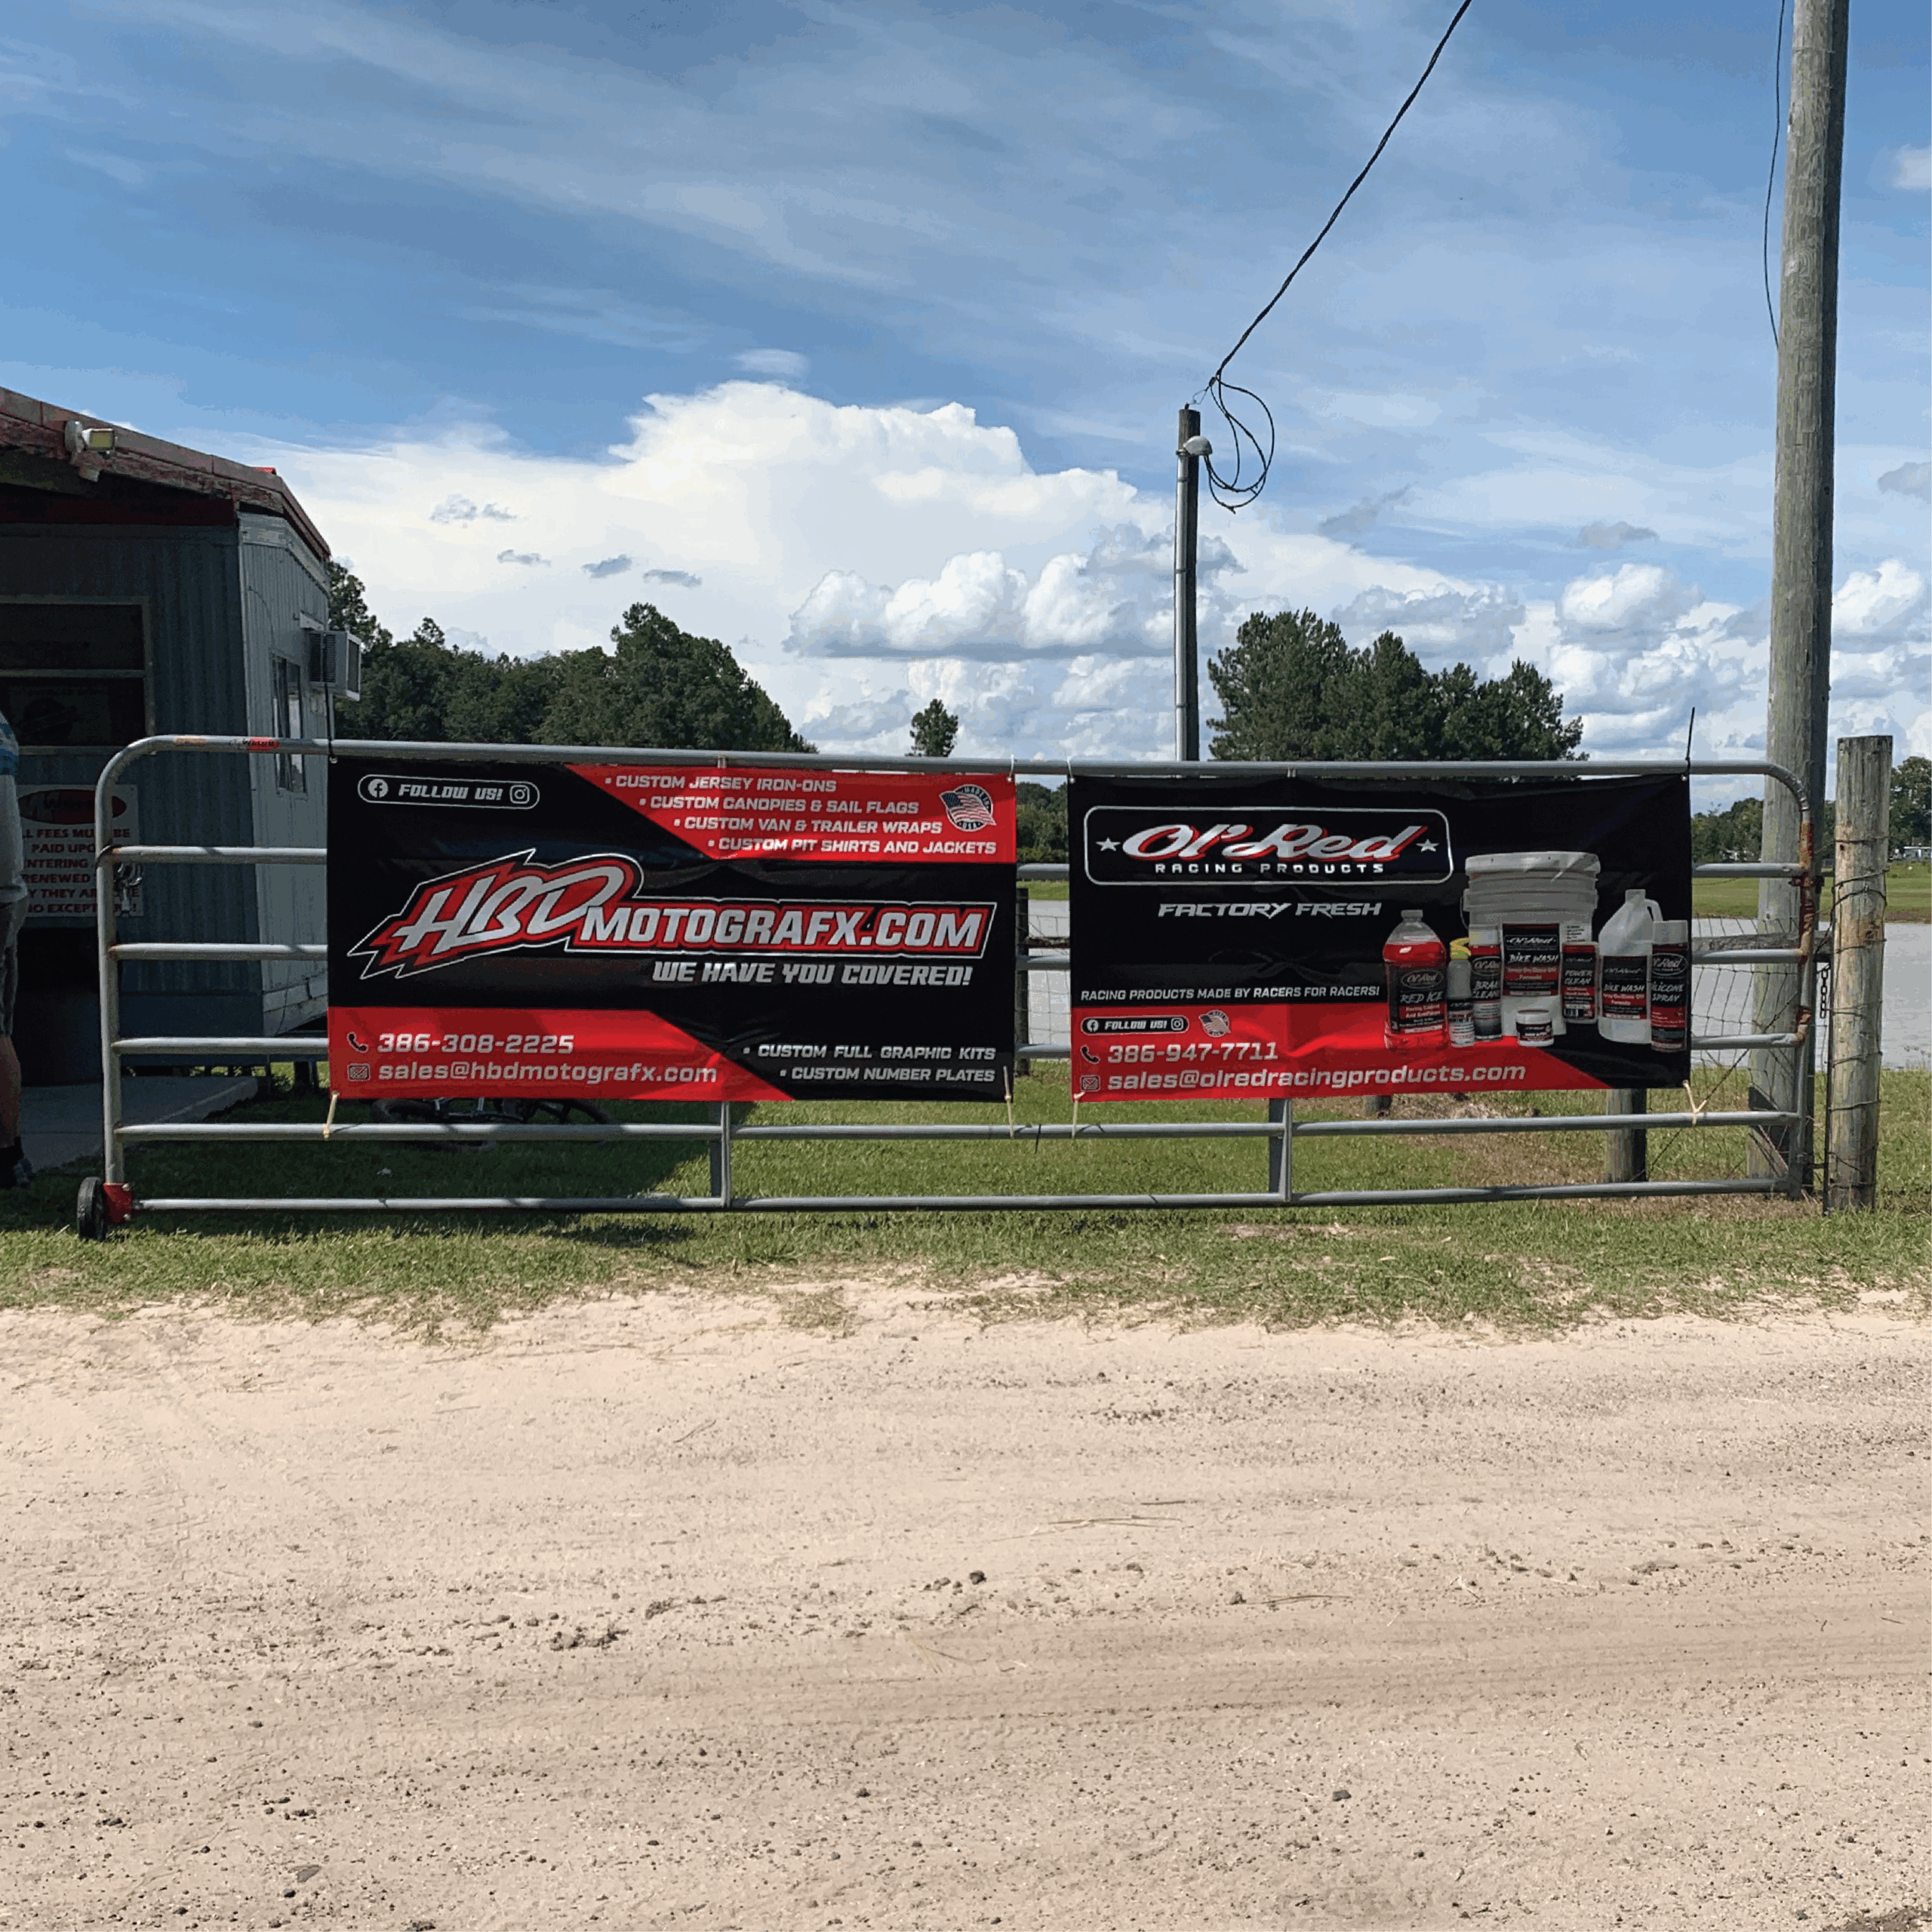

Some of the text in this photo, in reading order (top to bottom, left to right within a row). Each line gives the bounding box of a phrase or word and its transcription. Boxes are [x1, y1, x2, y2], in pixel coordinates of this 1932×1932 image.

[616, 775, 837, 792] CUSTOM JERSEY IRON-ONS
[398, 784, 503, 800] FOLLOW US!
[650, 795, 919, 814] CUSTOM CANOPIES & SAIL FLAGS
[685, 817, 943, 834] CUSTOM VAN & TRAILER WRAPS
[37, 829, 69, 838] FEES
[31, 844, 96, 854] PAID UPO
[718, 838, 997, 854] CUSTOM PIT SHIRTS AND JACKETS
[25, 859, 88, 869] NTERING
[1155, 863, 1385, 874] RACING PRODUCTS
[21, 873, 91, 883] RENEWED
[41, 888, 76, 899] THEY
[391, 866, 983, 955] HBD MOTOGRAFX.COM
[1158, 903, 1382, 918] FACTORY FRESH
[1533, 954, 1559, 964] WASH
[652, 961, 974, 986] WE HAVE YOU COVERED!
[1081, 986, 1380, 1001] RACING PRODUCTS MADE BY RACERS FOR RACERS!
[1400, 993, 1425, 1004] RED
[1652, 992, 1681, 1002] SPRAY
[1104, 1020, 1168, 1030] FOLLOW US!
[377, 1032, 574, 1054] 386-308-2225
[758, 1044, 996, 1060] CUSTOM FULL GRAPHIC KITS
[1107, 1041, 1278, 1063] 386-947-7711
[378, 1062, 718, 1084] sales@hbdmotografx.com
[792, 1067, 995, 1082] CUSTOM NUMBER PLATES
[1107, 1065, 1526, 1090] sales@olredracingproducts.com
